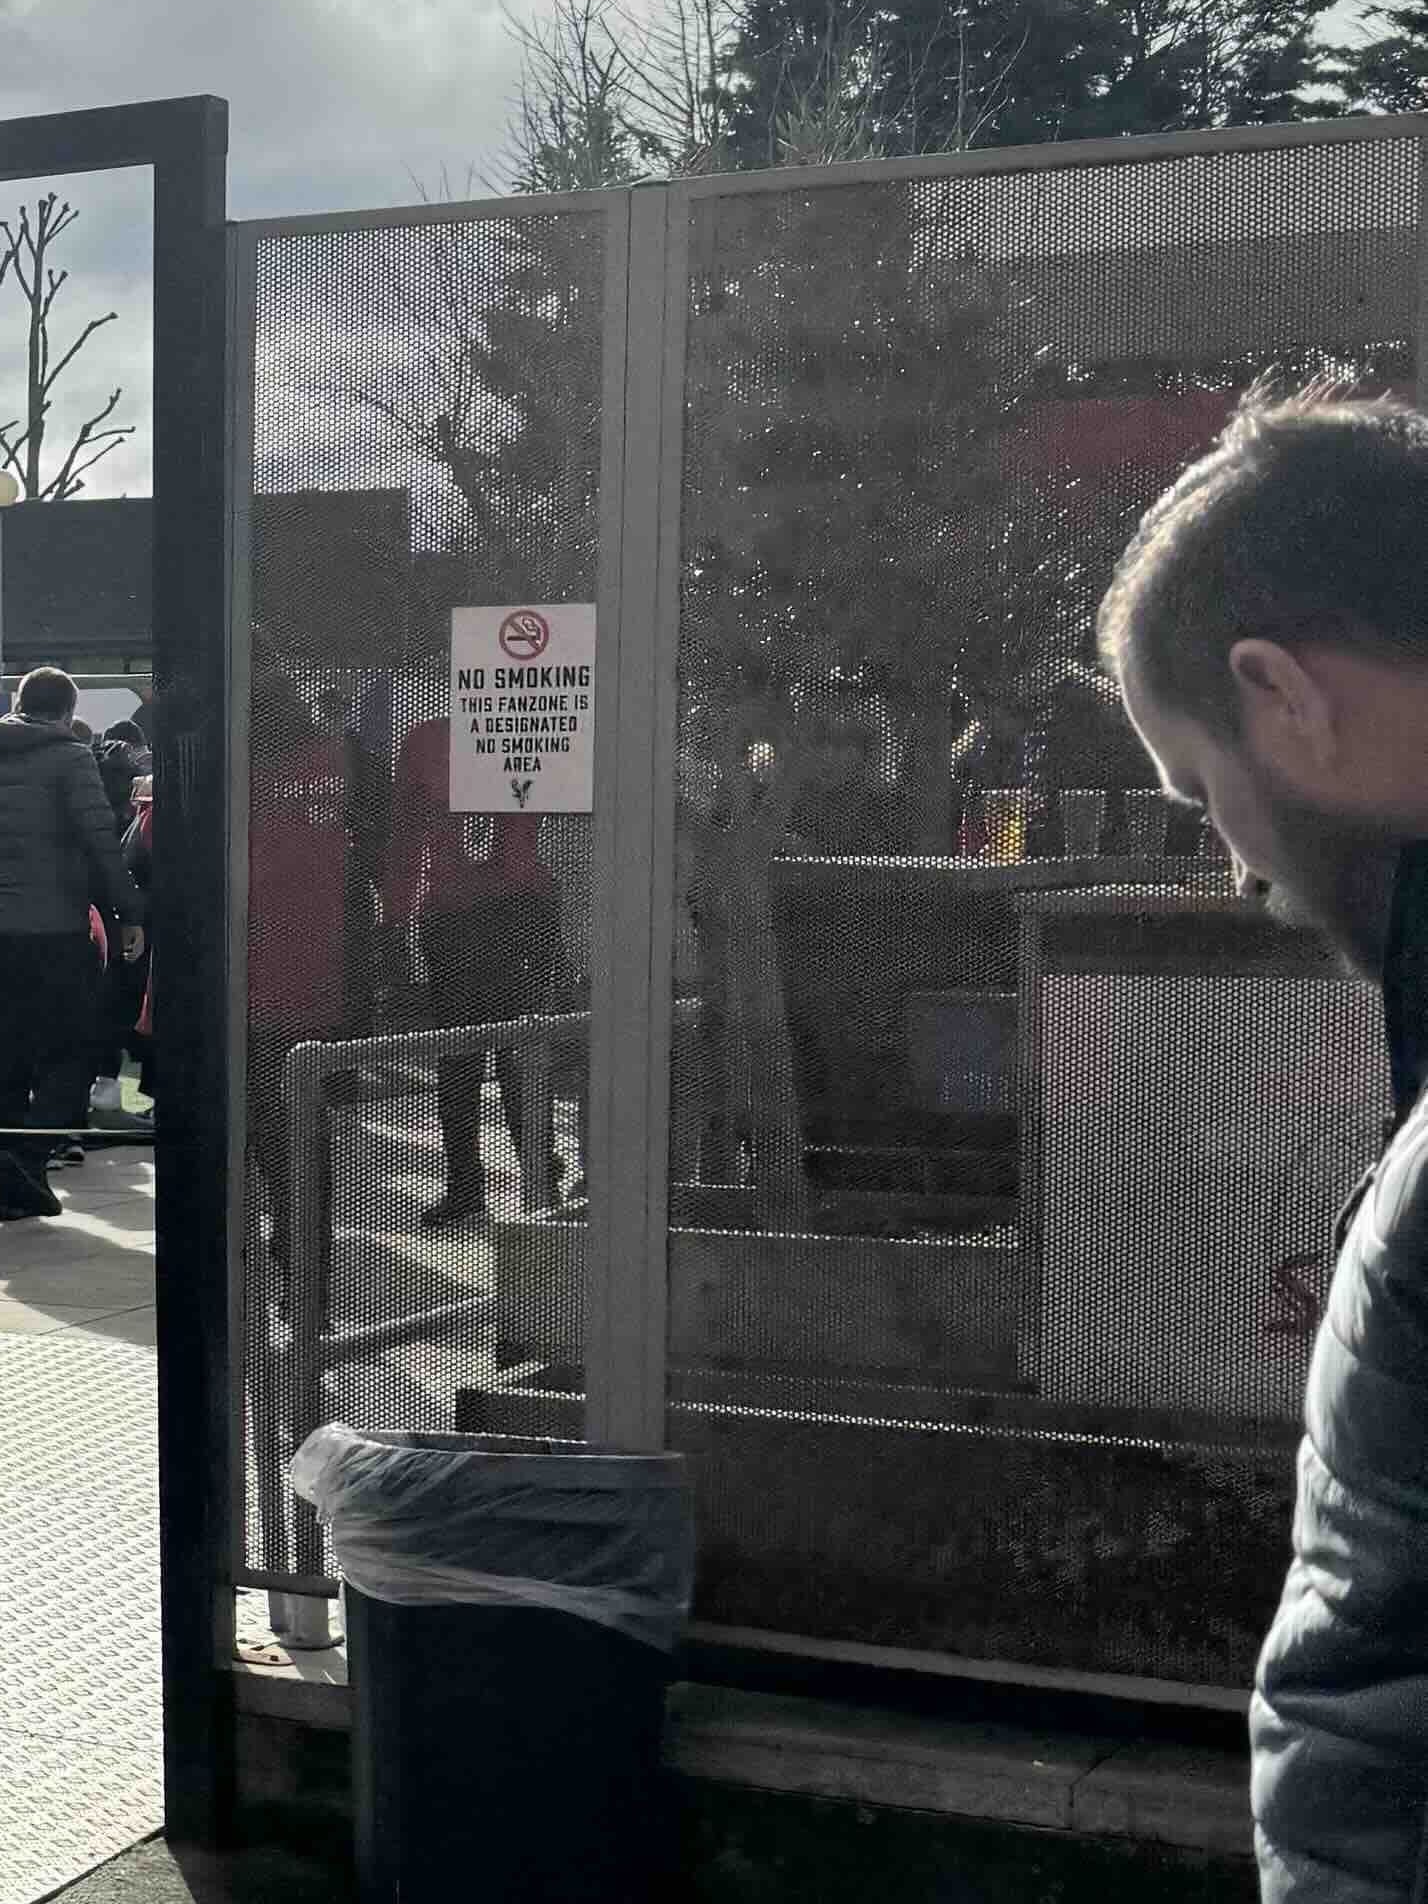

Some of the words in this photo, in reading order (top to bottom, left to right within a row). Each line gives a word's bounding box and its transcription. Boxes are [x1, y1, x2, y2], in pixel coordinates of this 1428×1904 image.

[458, 669, 485, 690] NO
[494, 666, 591, 689] SMOKING
[460, 698, 493, 713] THIS
[498, 696, 568, 712] FANZONE
[574, 695, 589, 710] IS
[470, 718, 480, 733] A
[485, 716, 578, 733] DESIGNATED
[476, 738, 496, 754] NO
[501, 737, 570, 753] SMOKING
[503, 757, 542, 773] AREA
